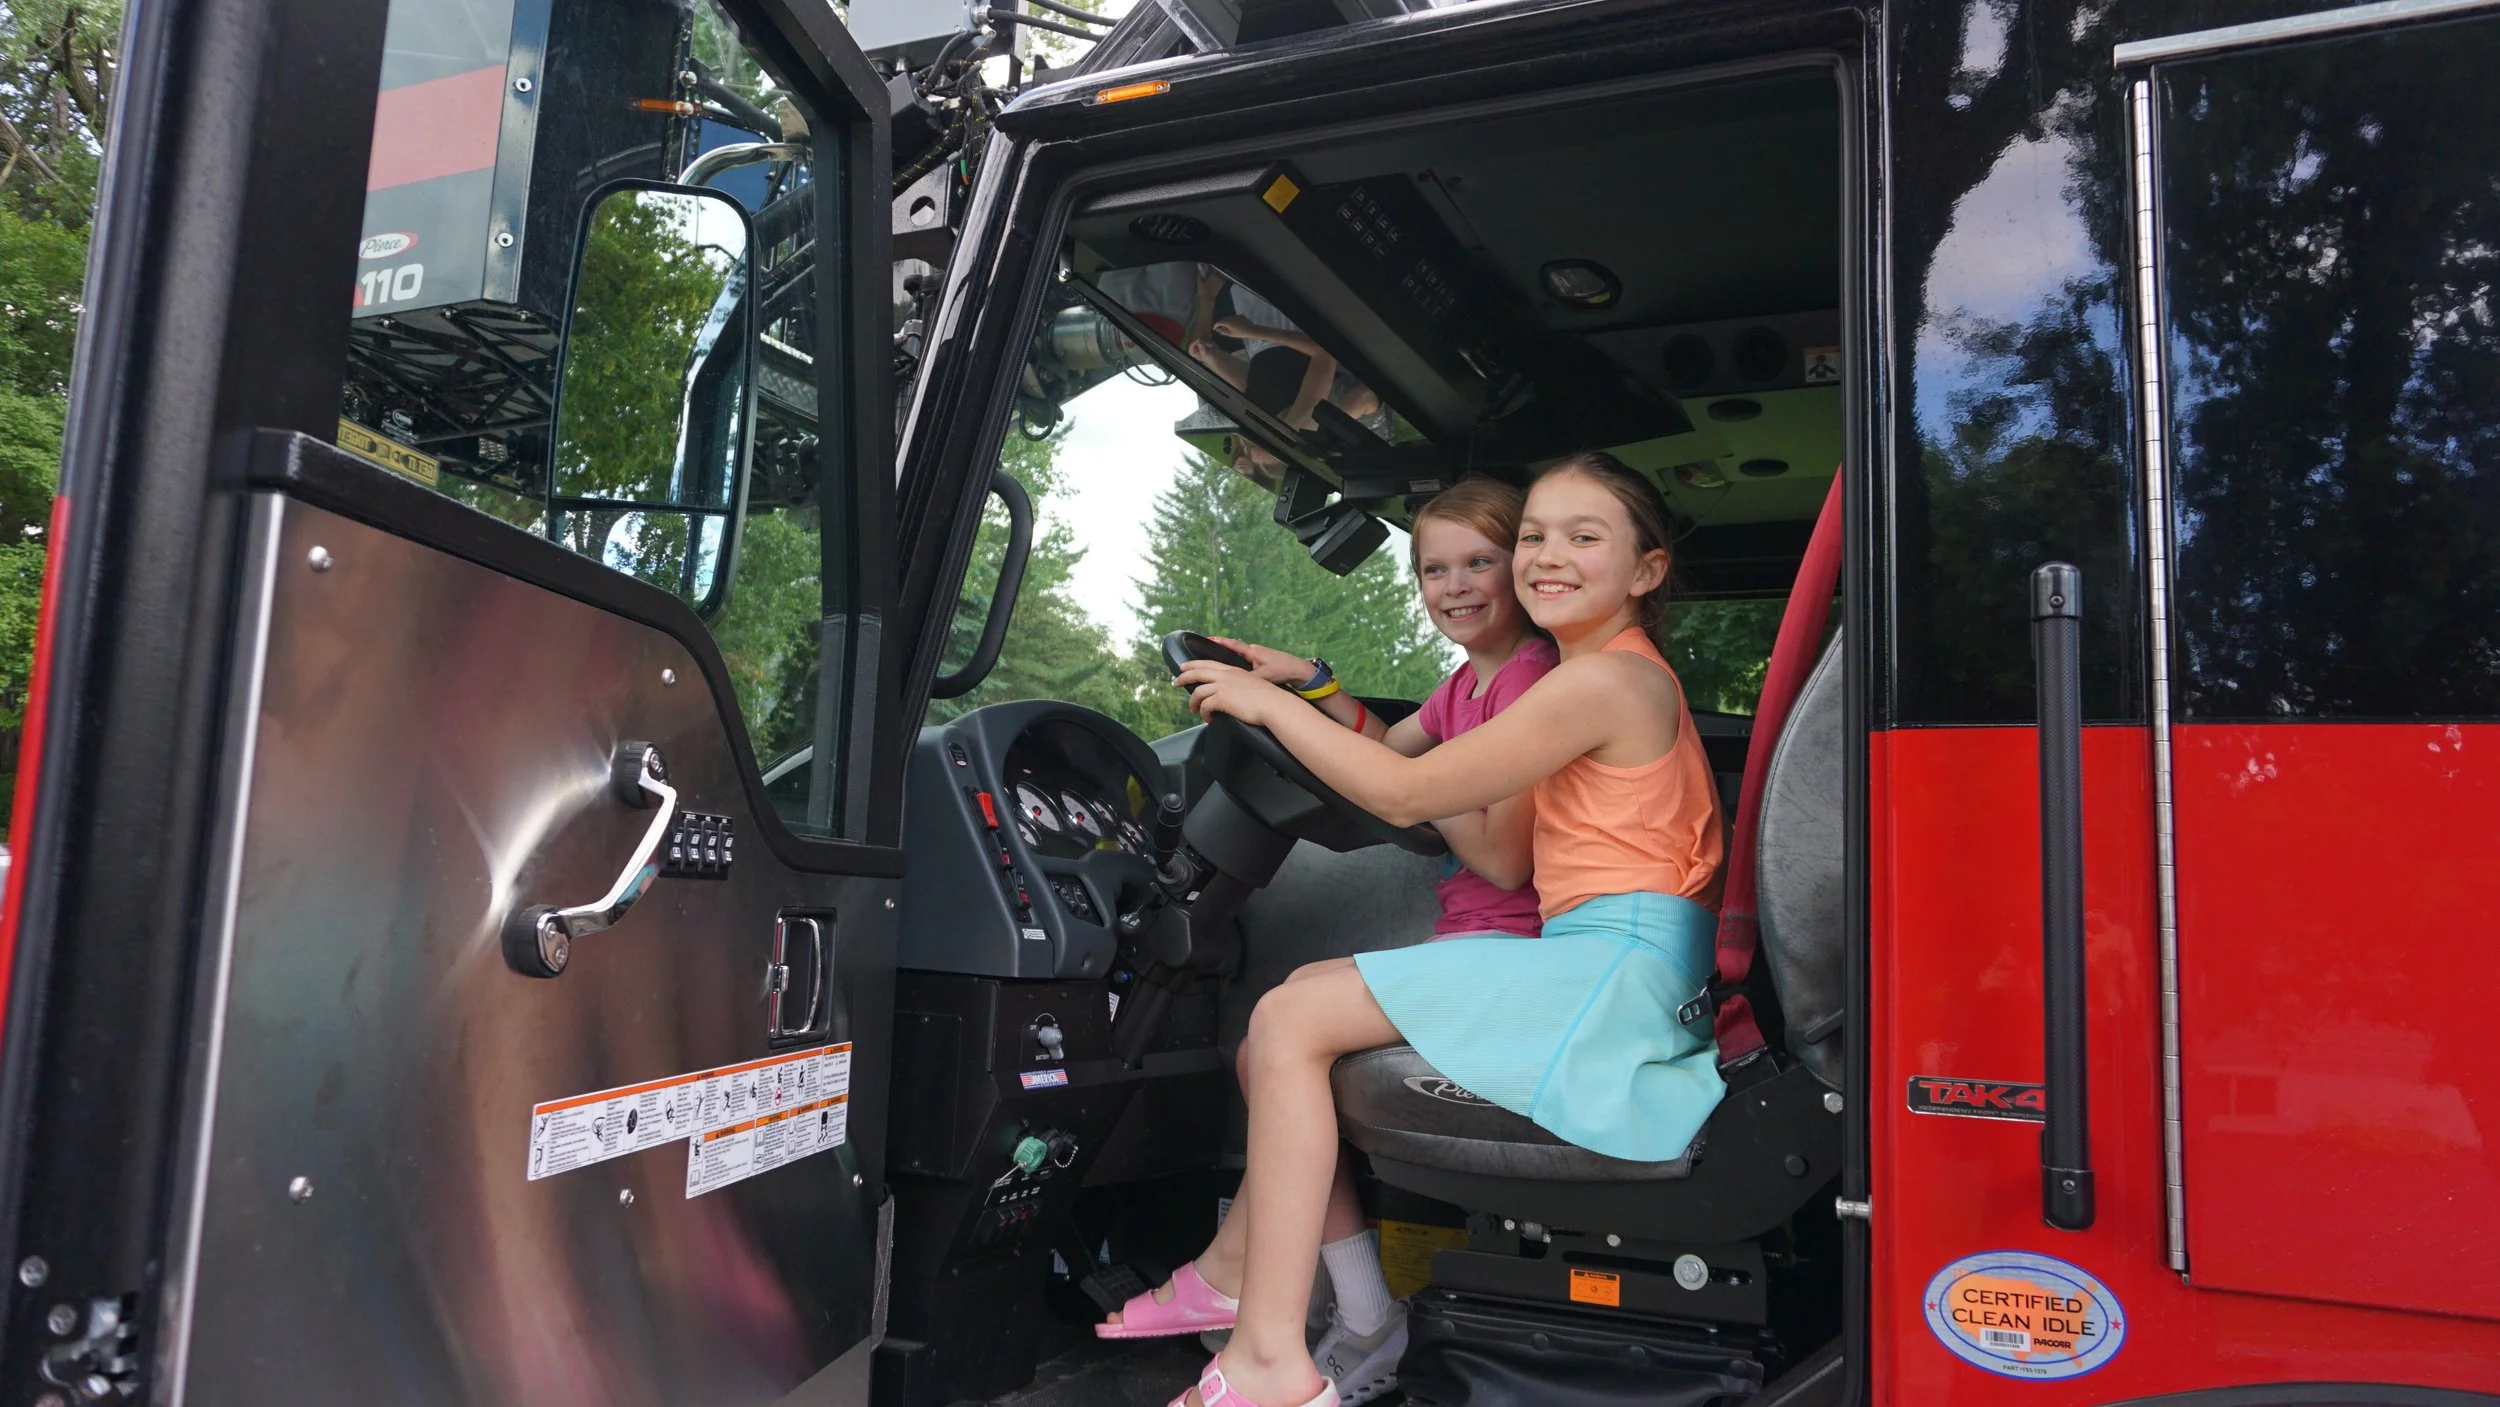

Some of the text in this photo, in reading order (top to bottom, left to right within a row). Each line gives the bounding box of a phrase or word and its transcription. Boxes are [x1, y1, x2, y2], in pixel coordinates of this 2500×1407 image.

[362, 239, 402, 256] Pierce
[361, 263, 424, 306] 110
[1032, 1073, 1059, 1085] AMERICA
[1433, 1080, 1482, 1100] Pie
[1918, 1080, 2046, 1112] TAK-4
[1963, 1288, 2083, 1314] CERTIFIED
[1952, 1308, 2096, 1336] CLEAN IDLE
[2033, 1337, 2072, 1350] PACCAR
[2002, 1364, 2018, 1372] PART
